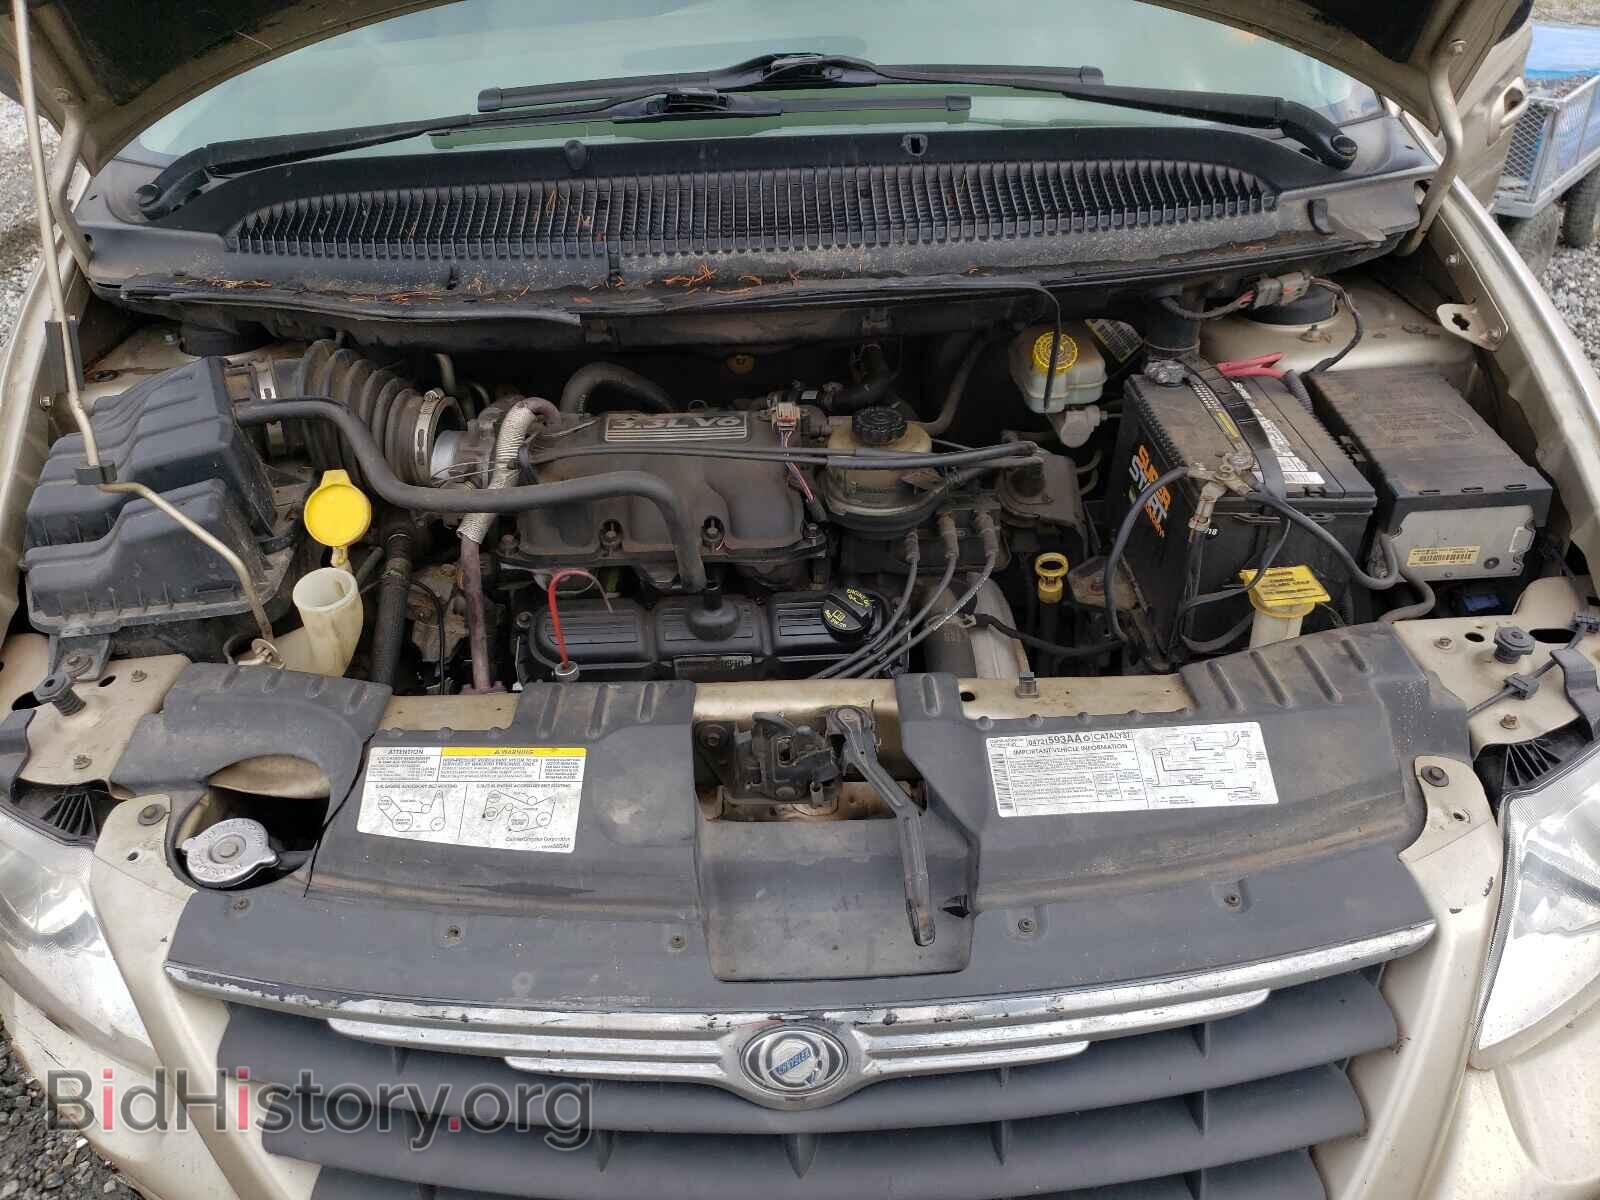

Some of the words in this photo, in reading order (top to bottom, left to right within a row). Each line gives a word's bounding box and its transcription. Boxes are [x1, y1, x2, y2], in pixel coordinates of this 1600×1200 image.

[695, 416, 742, 427] V6
[1093, 731, 1130, 740] CATALYST
[1013, 747, 1052, 755] IMPORTANT
[1052, 745, 1078, 753] VEHICLE
[1080, 743, 1128, 751] INFORMATION
